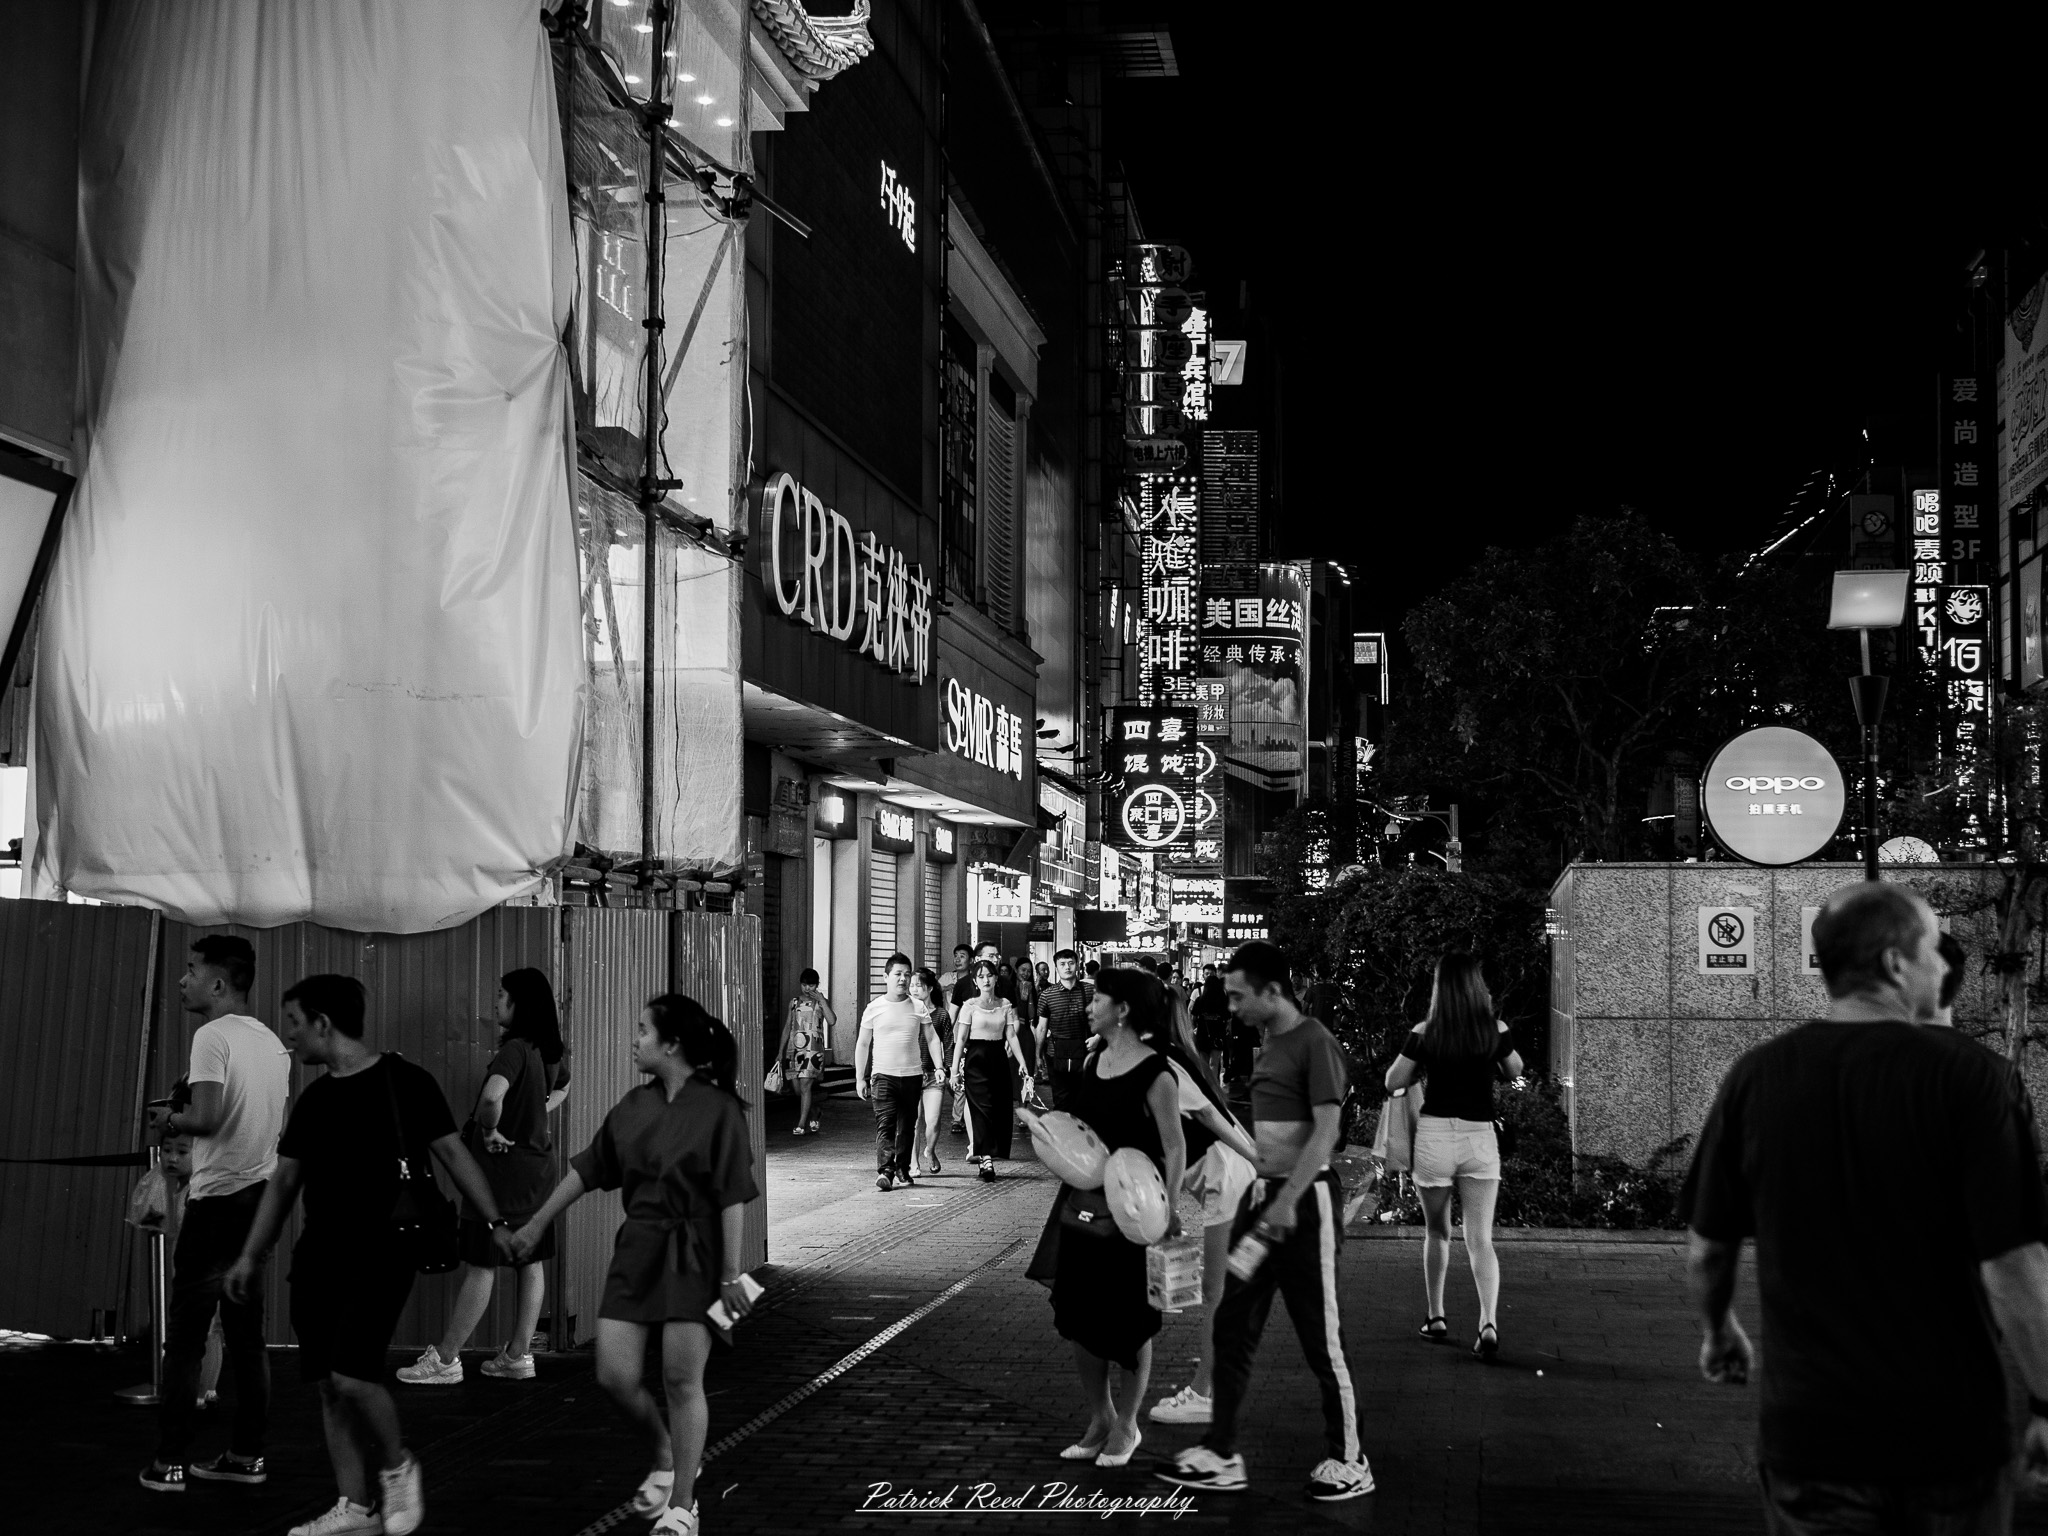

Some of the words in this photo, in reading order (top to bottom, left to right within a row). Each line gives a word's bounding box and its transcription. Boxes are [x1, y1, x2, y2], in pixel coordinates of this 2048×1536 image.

[1952, 377, 1980, 529] 爱尚造型
[769, 471, 857, 642] CRD
[1951, 539, 1981, 560] 3F
[1123, 716, 1187, 742] 四喜
[1123, 753, 1187, 776] 馄饨
[1747, 803, 1803, 816] 拍照手机
